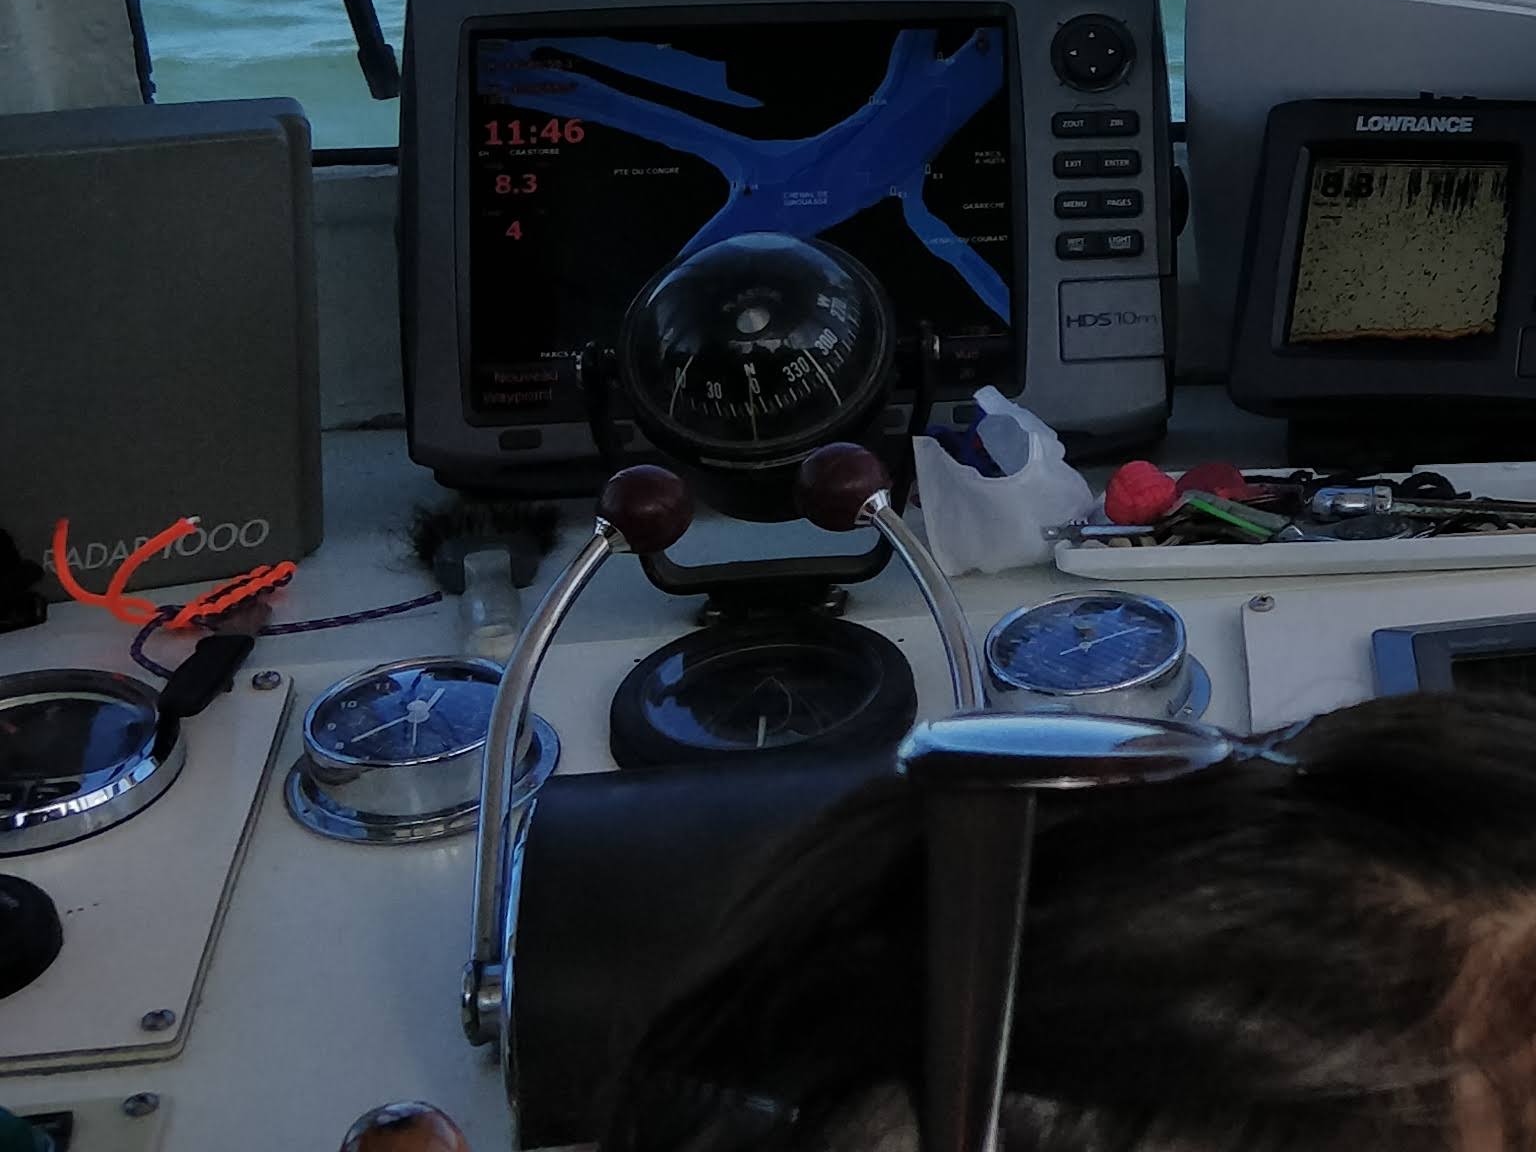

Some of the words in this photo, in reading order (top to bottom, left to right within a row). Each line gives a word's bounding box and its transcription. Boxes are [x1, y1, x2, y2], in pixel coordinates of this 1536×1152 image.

[484, 118, 585, 145] 11:46
[1356, 115, 1474, 133] LOWRANCE
[1065, 159, 1083, 168] EXIT
[495, 174, 539, 194] 8.3
[1063, 200, 1088, 209] MENU
[1107, 199, 1132, 207] PAGES
[506, 220, 523, 240] 4
[815, 328, 839, 356] 300
[783, 356, 811, 383] 330
[706, 381, 723, 400] 30
